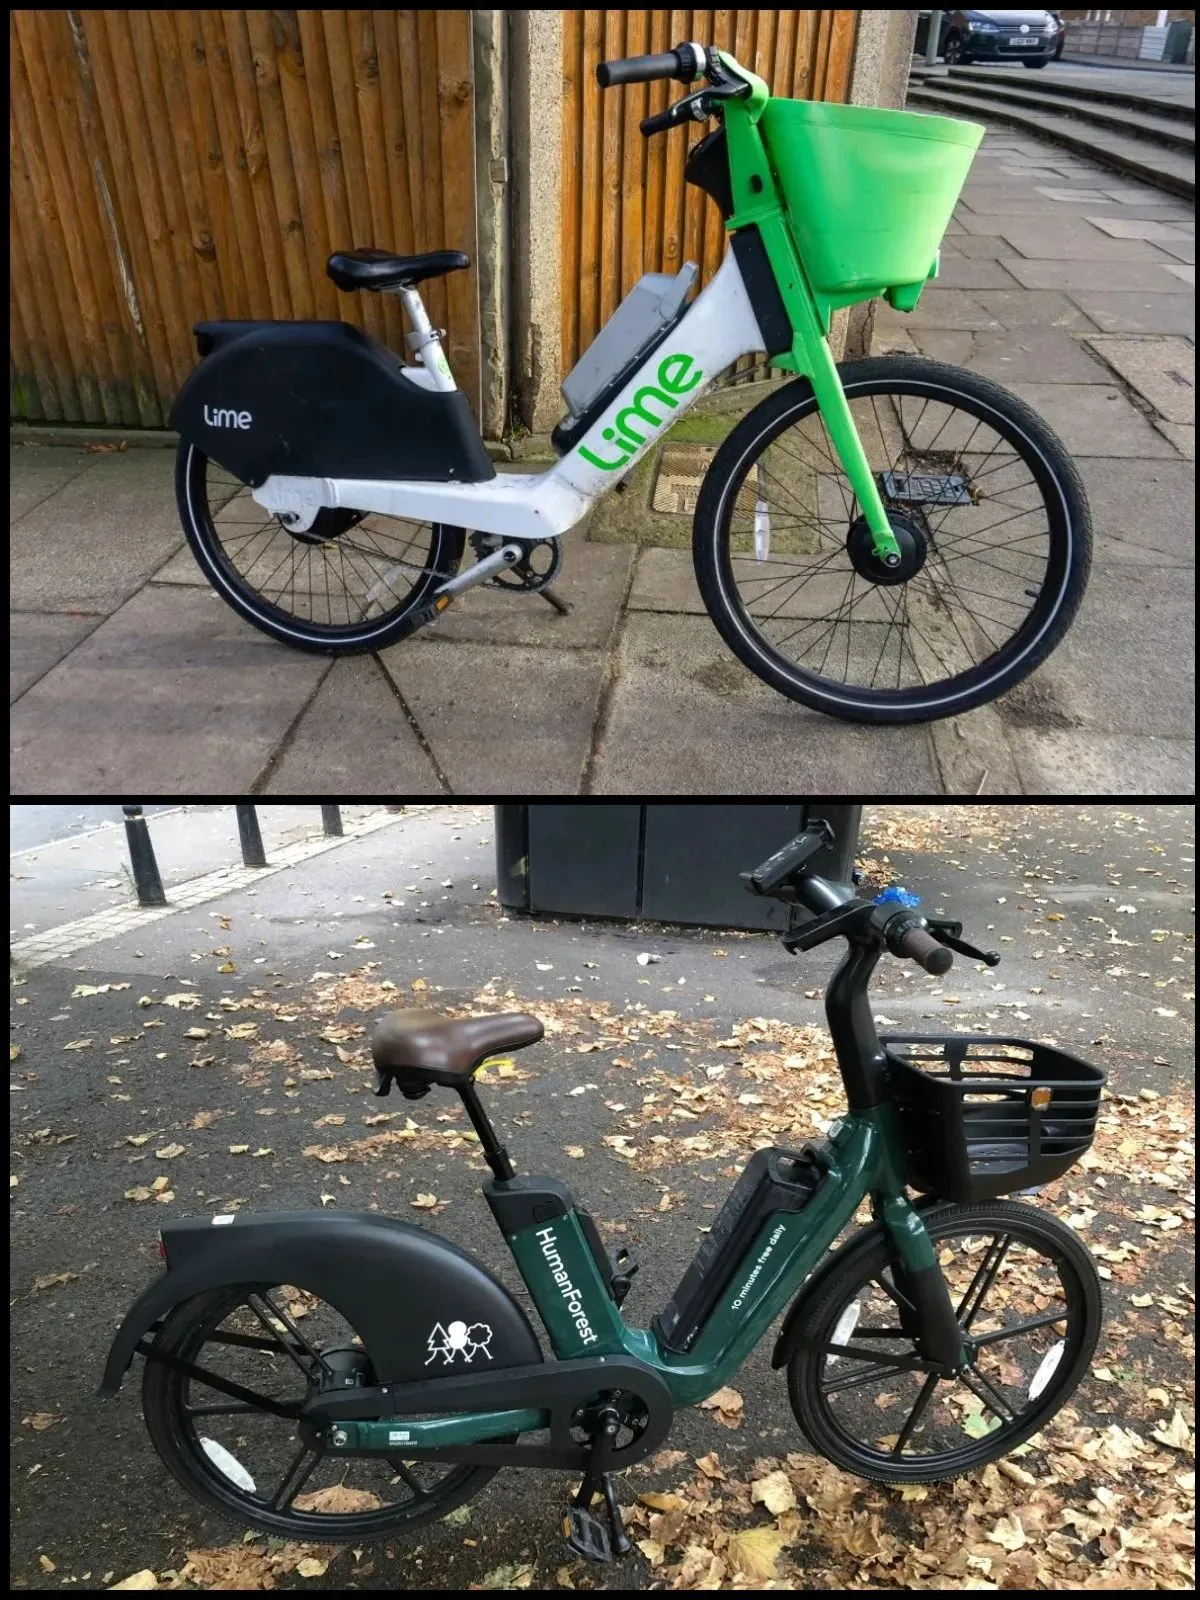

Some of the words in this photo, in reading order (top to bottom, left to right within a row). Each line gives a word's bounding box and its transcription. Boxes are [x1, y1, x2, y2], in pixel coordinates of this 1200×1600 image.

[204, 404, 252, 429] Lime
[577, 353, 703, 470] Lime
[535, 1226, 598, 1346] HumanForest
[731, 1299, 742, 1310] 10
[739, 1264, 762, 1299] minutes
[757, 1246, 773, 1264] free
[769, 1223, 786, 1246] daily
